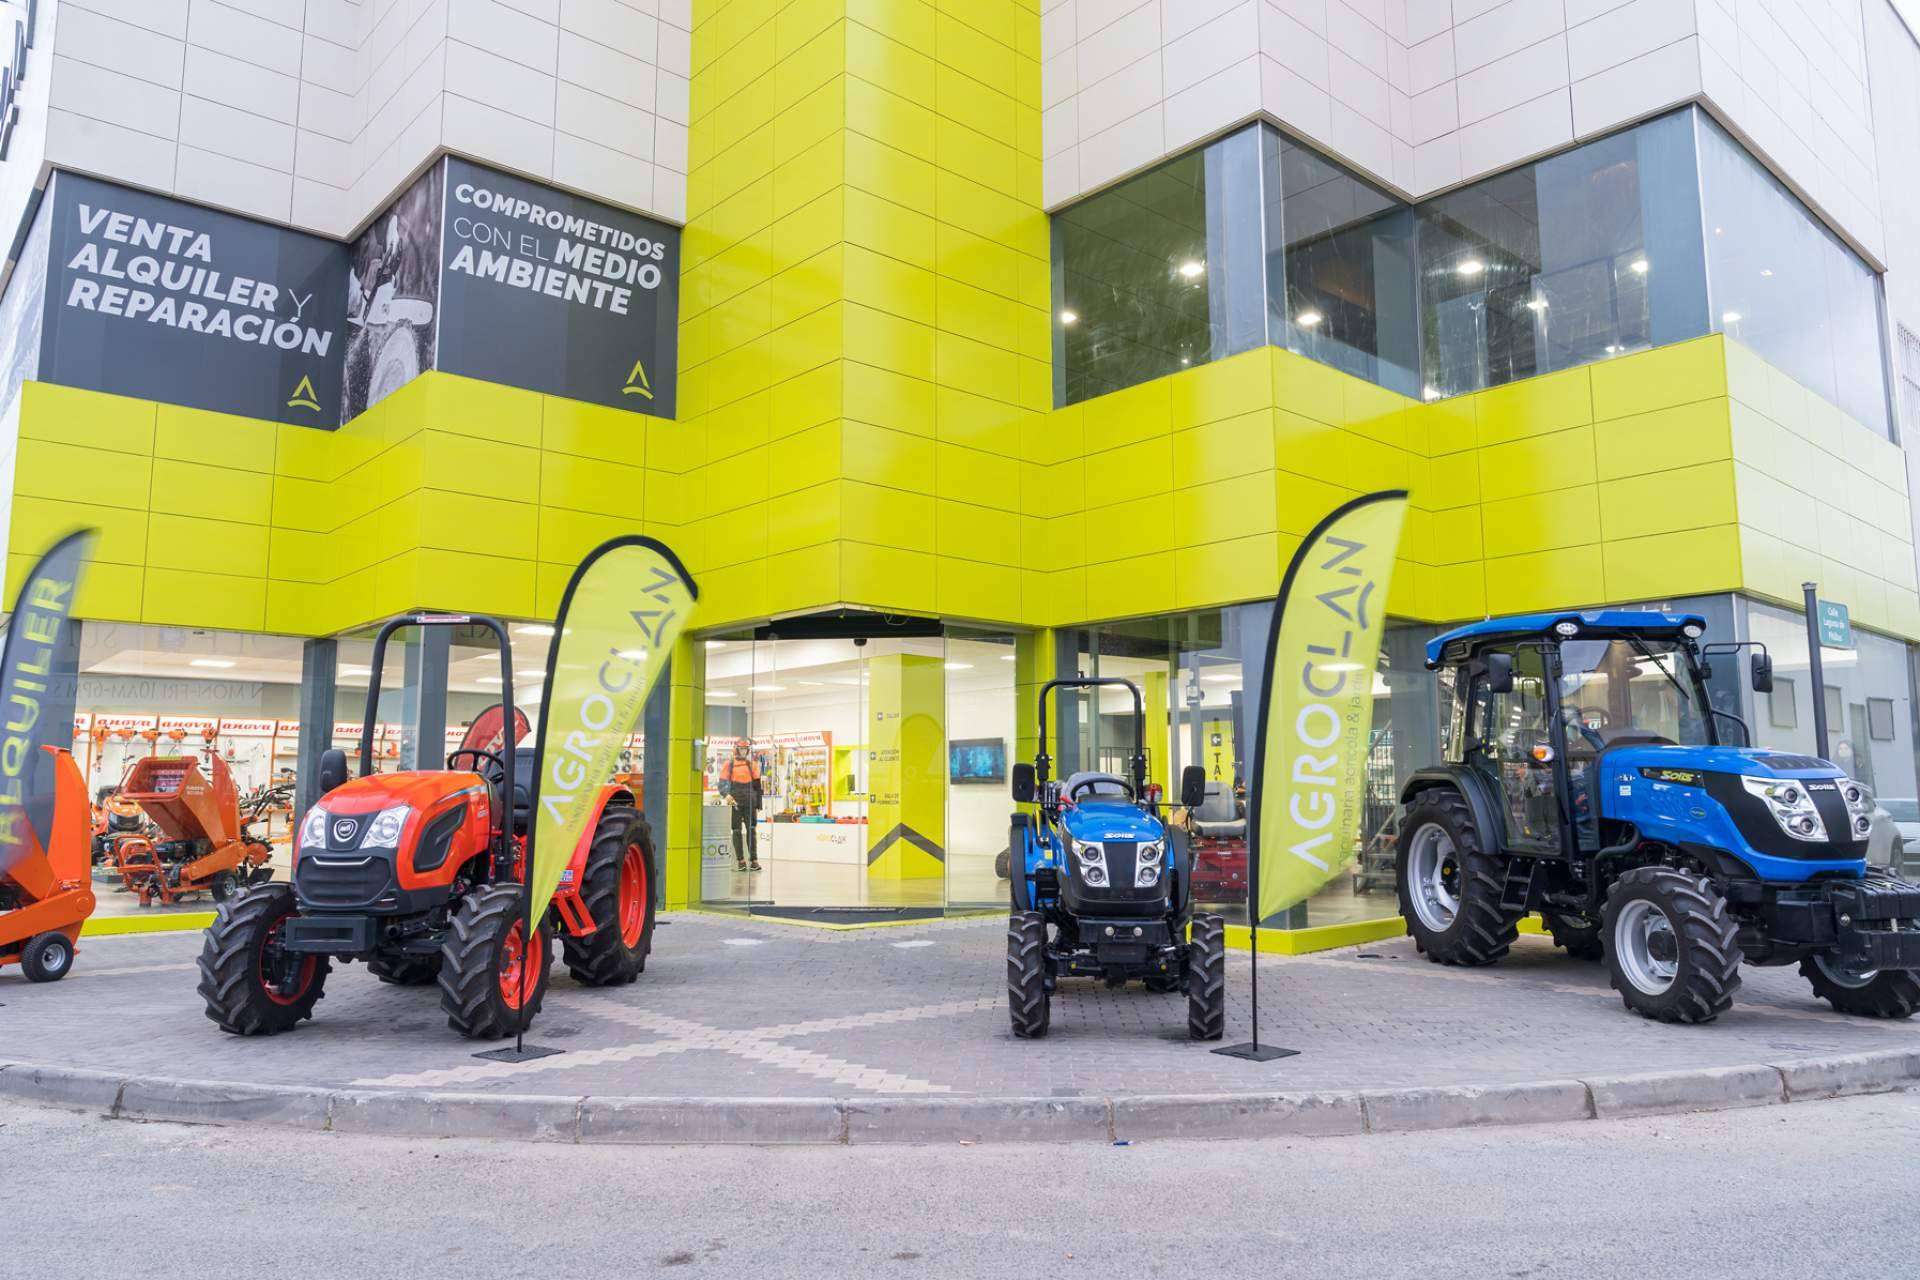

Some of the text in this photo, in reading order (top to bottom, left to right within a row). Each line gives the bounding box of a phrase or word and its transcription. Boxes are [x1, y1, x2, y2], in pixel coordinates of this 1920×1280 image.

[78, 203, 212, 263] VENTA
[454, 217, 662, 290] CON EL MEDIO
[455, 183, 665, 261] COMPROMETIDOS
[66, 278, 333, 357] REPARACIÓN
[67, 243, 313, 318] ALQUILER Y
[449, 245, 632, 316] AMBIENTE
[1287, 536, 1375, 873] AGROCLAN
